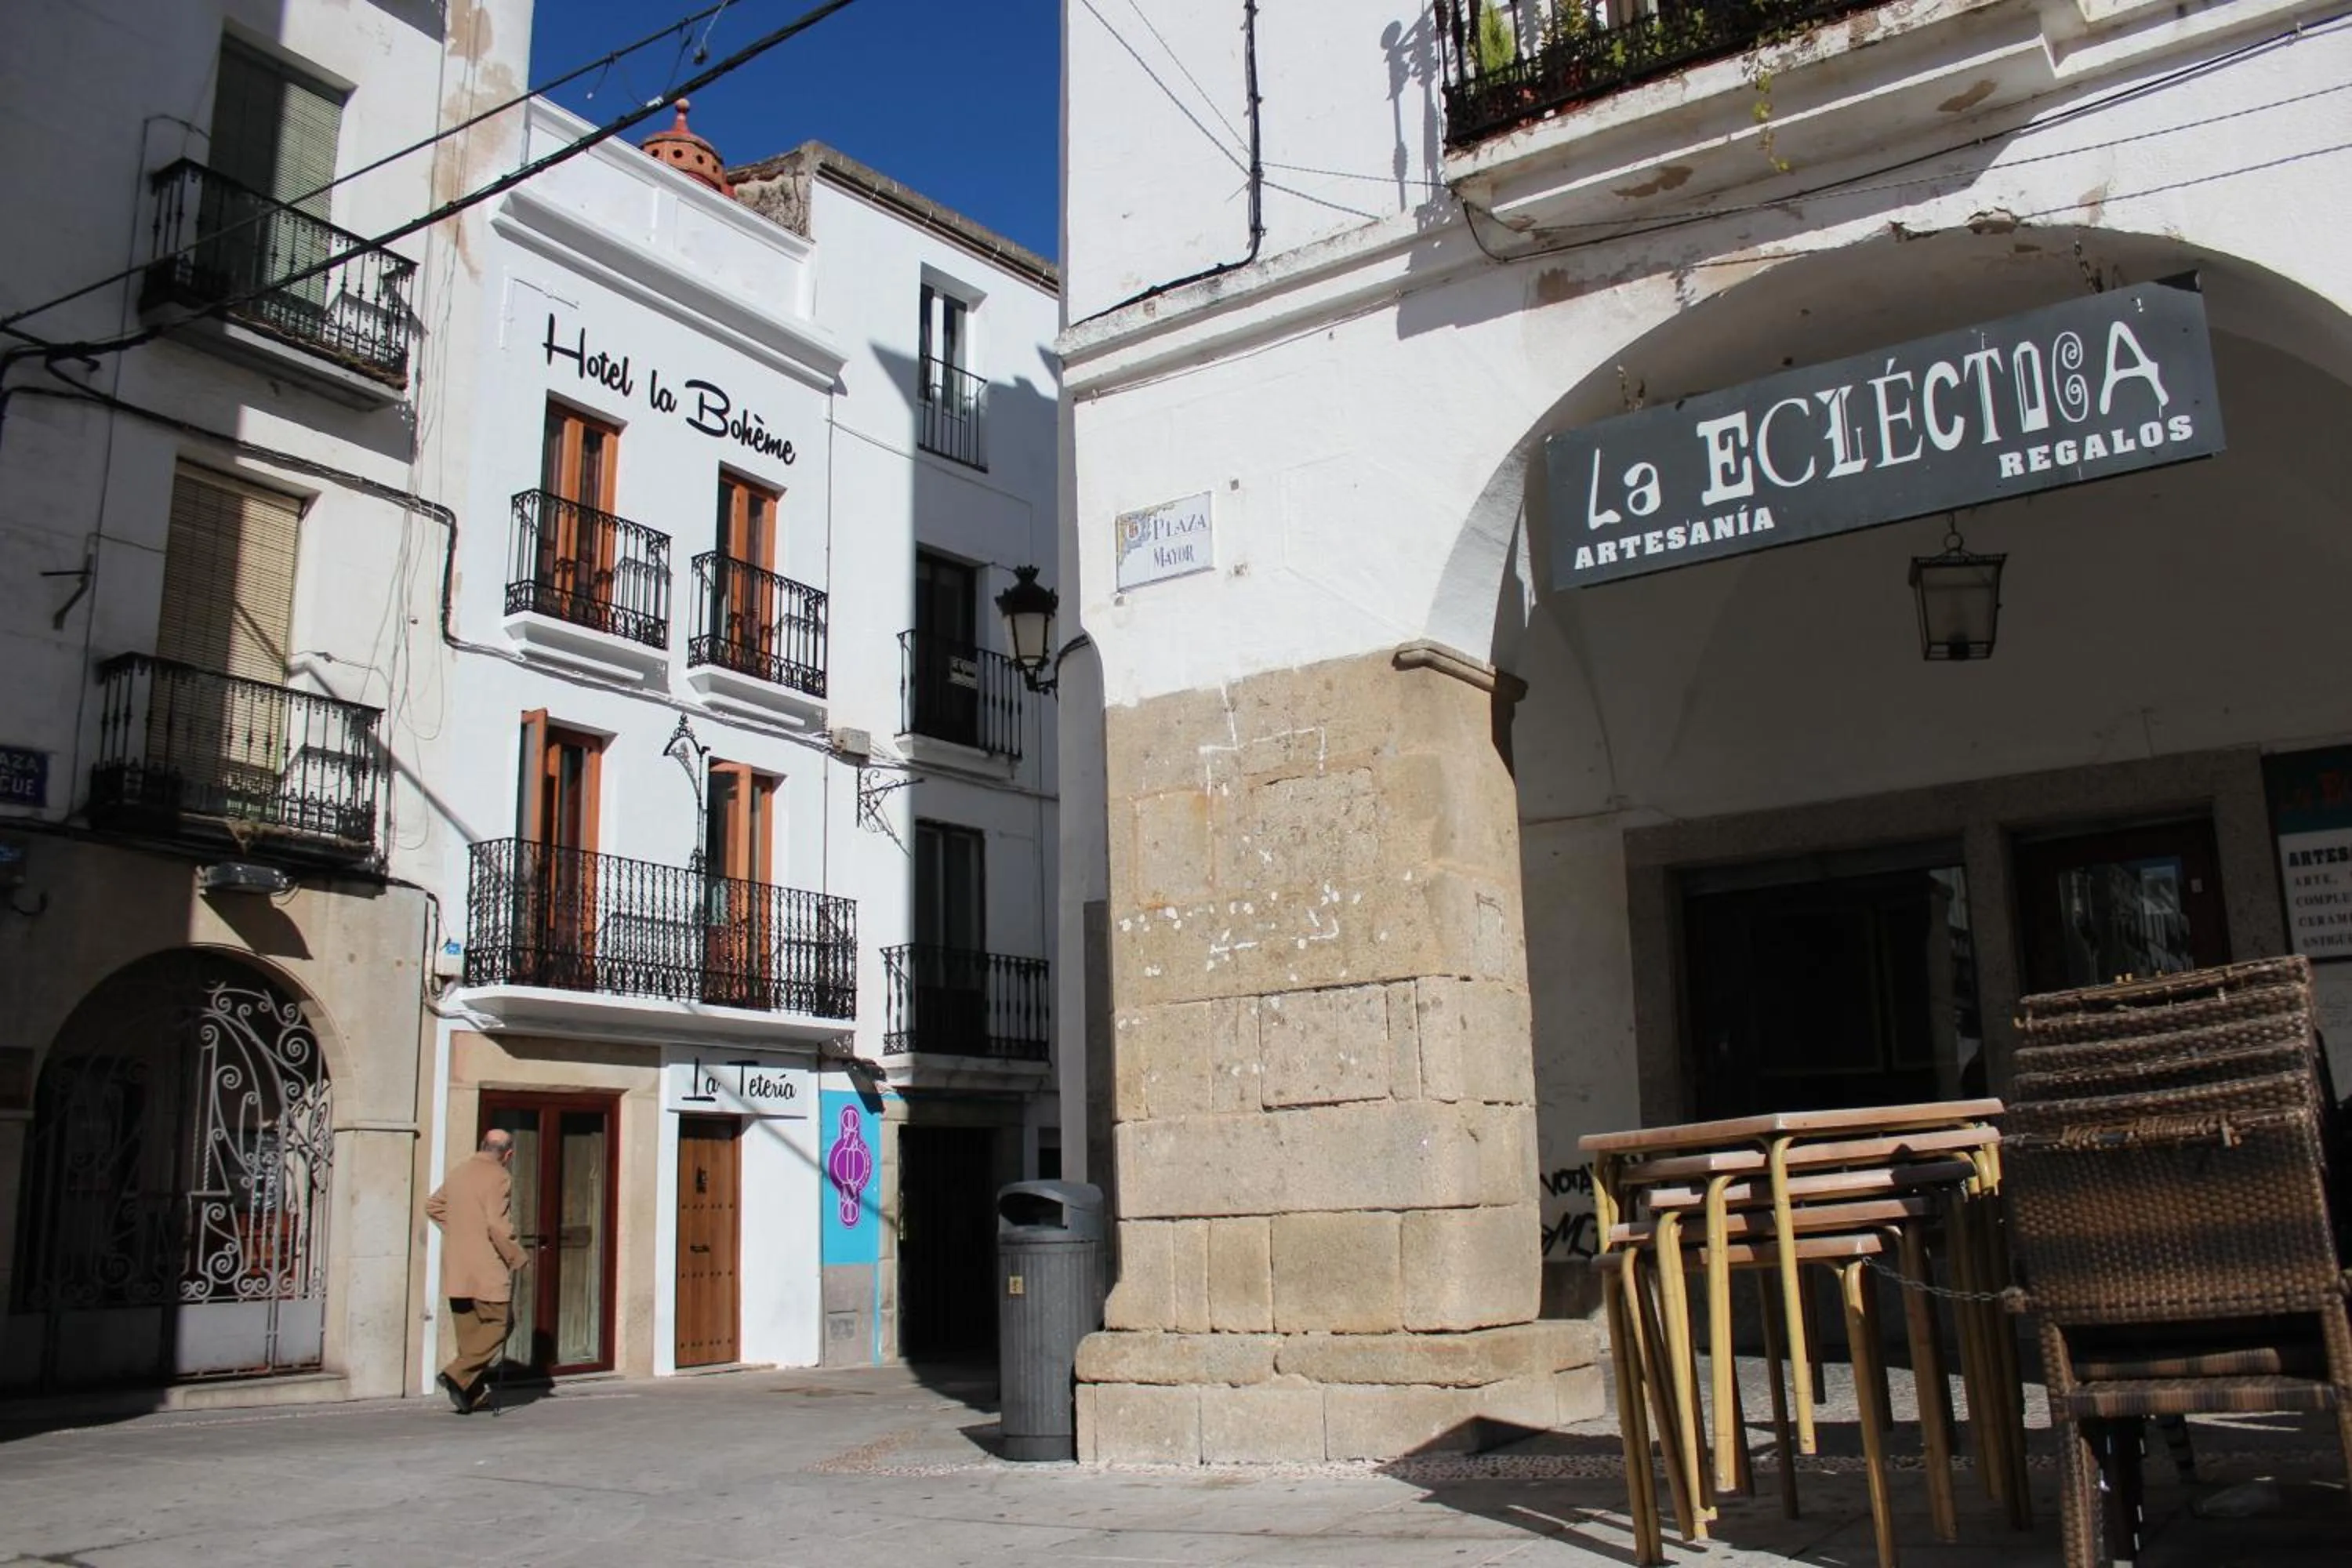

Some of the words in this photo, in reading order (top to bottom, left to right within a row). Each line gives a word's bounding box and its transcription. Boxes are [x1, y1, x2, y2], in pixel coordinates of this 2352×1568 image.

[543, 313, 633, 397] Hotel
[650, 369, 677, 413] la
[685, 379, 797, 466] Bohème
[1999, 415, 2194, 479] REGALOS
[1588, 448, 1661, 530] La
[1153, 514, 1207, 541] PLAZA
[1153, 545, 1195, 568] MAYOR
[1574, 504, 1775, 571] ARTESANÍA
[681, 1057, 720, 1102] La
[727, 1060, 797, 1100] Tetería
